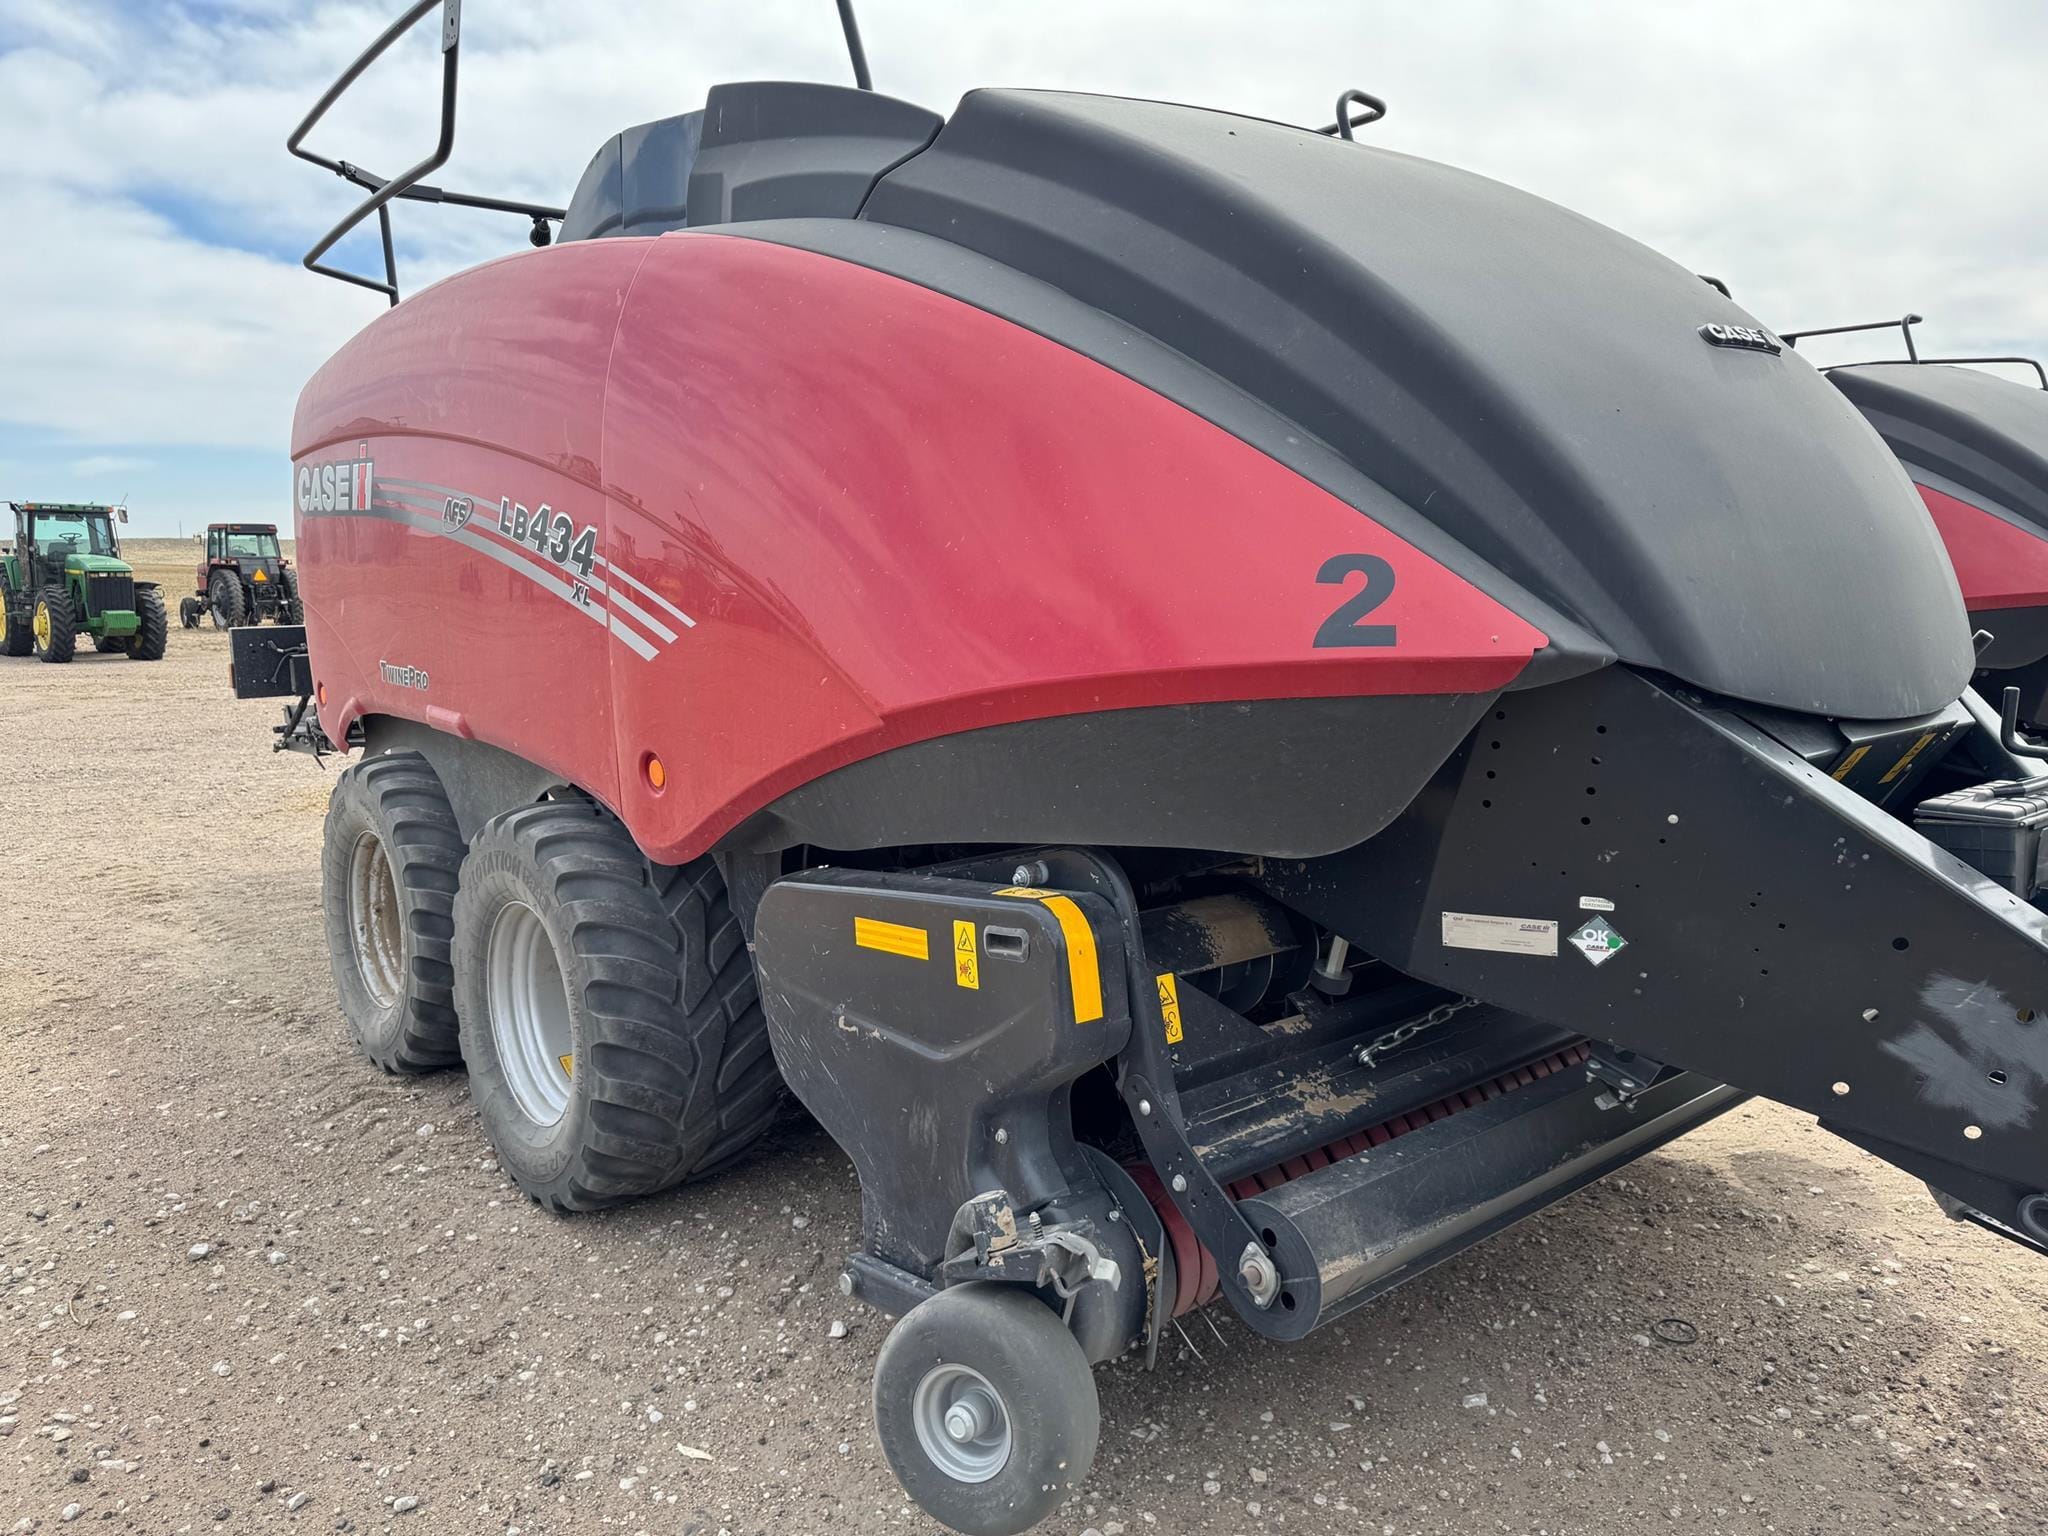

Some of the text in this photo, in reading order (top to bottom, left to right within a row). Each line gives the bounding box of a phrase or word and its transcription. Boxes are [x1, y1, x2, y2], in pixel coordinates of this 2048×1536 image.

[1705, 323, 1766, 343] CASE
[297, 462, 350, 513] CASE
[442, 497, 468, 527] AFS
[498, 495, 598, 582] LB434
[570, 579, 592, 607] XL
[1312, 552, 1397, 648] 2
[1582, 929, 1609, 942] OK
